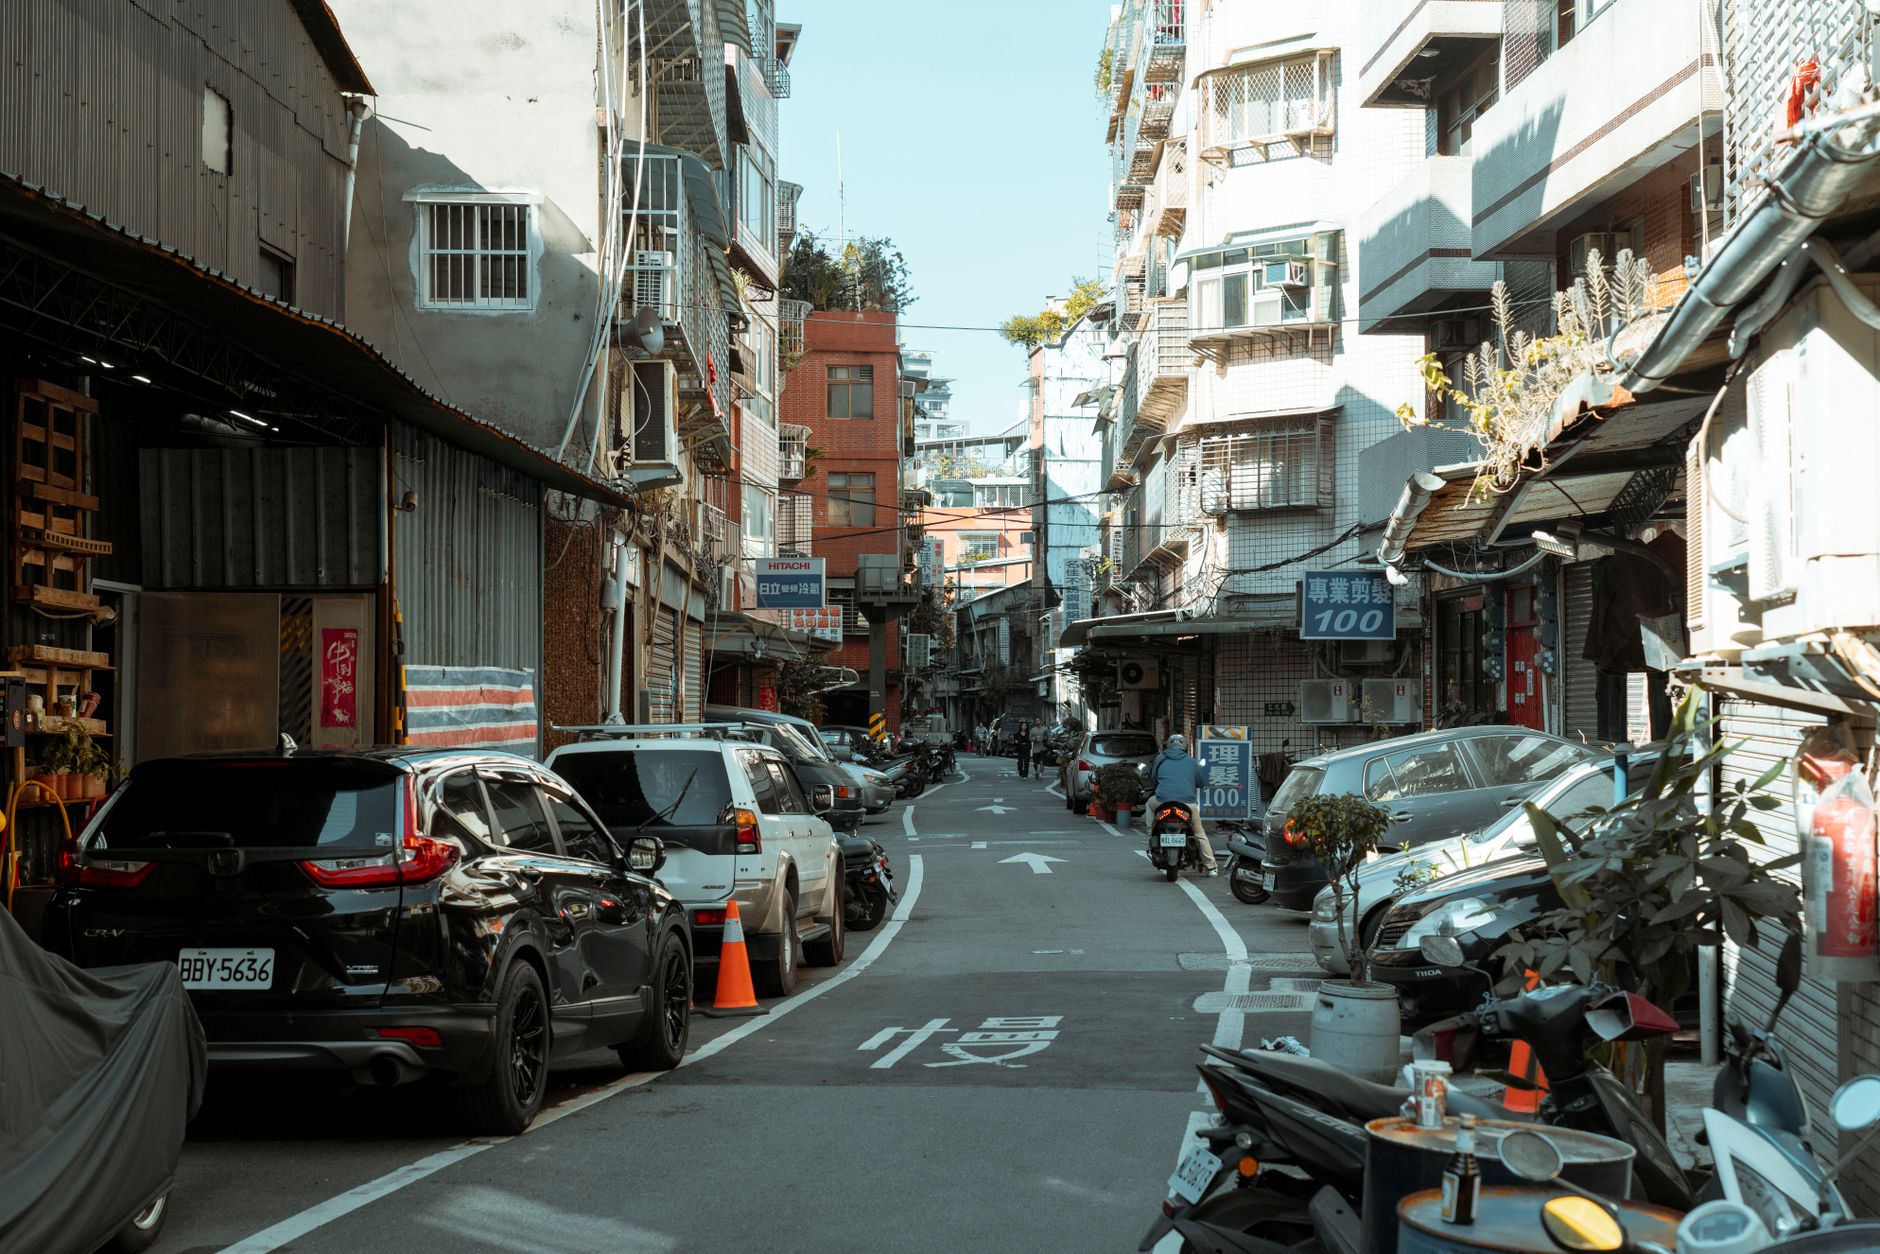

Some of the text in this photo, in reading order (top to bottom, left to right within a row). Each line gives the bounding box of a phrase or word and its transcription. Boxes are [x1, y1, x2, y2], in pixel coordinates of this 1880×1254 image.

[768, 562, 810, 571] HITACHI
[1308, 577, 1392, 605] 專業剪髮
[1314, 609, 1384, 633] 100
[1208, 745, 1240, 786] 理髮
[1203, 788, 1240, 807] 100
[1414, 968, 1443, 977] TIIDA
[856, 1015, 1065, 1069] 慢
